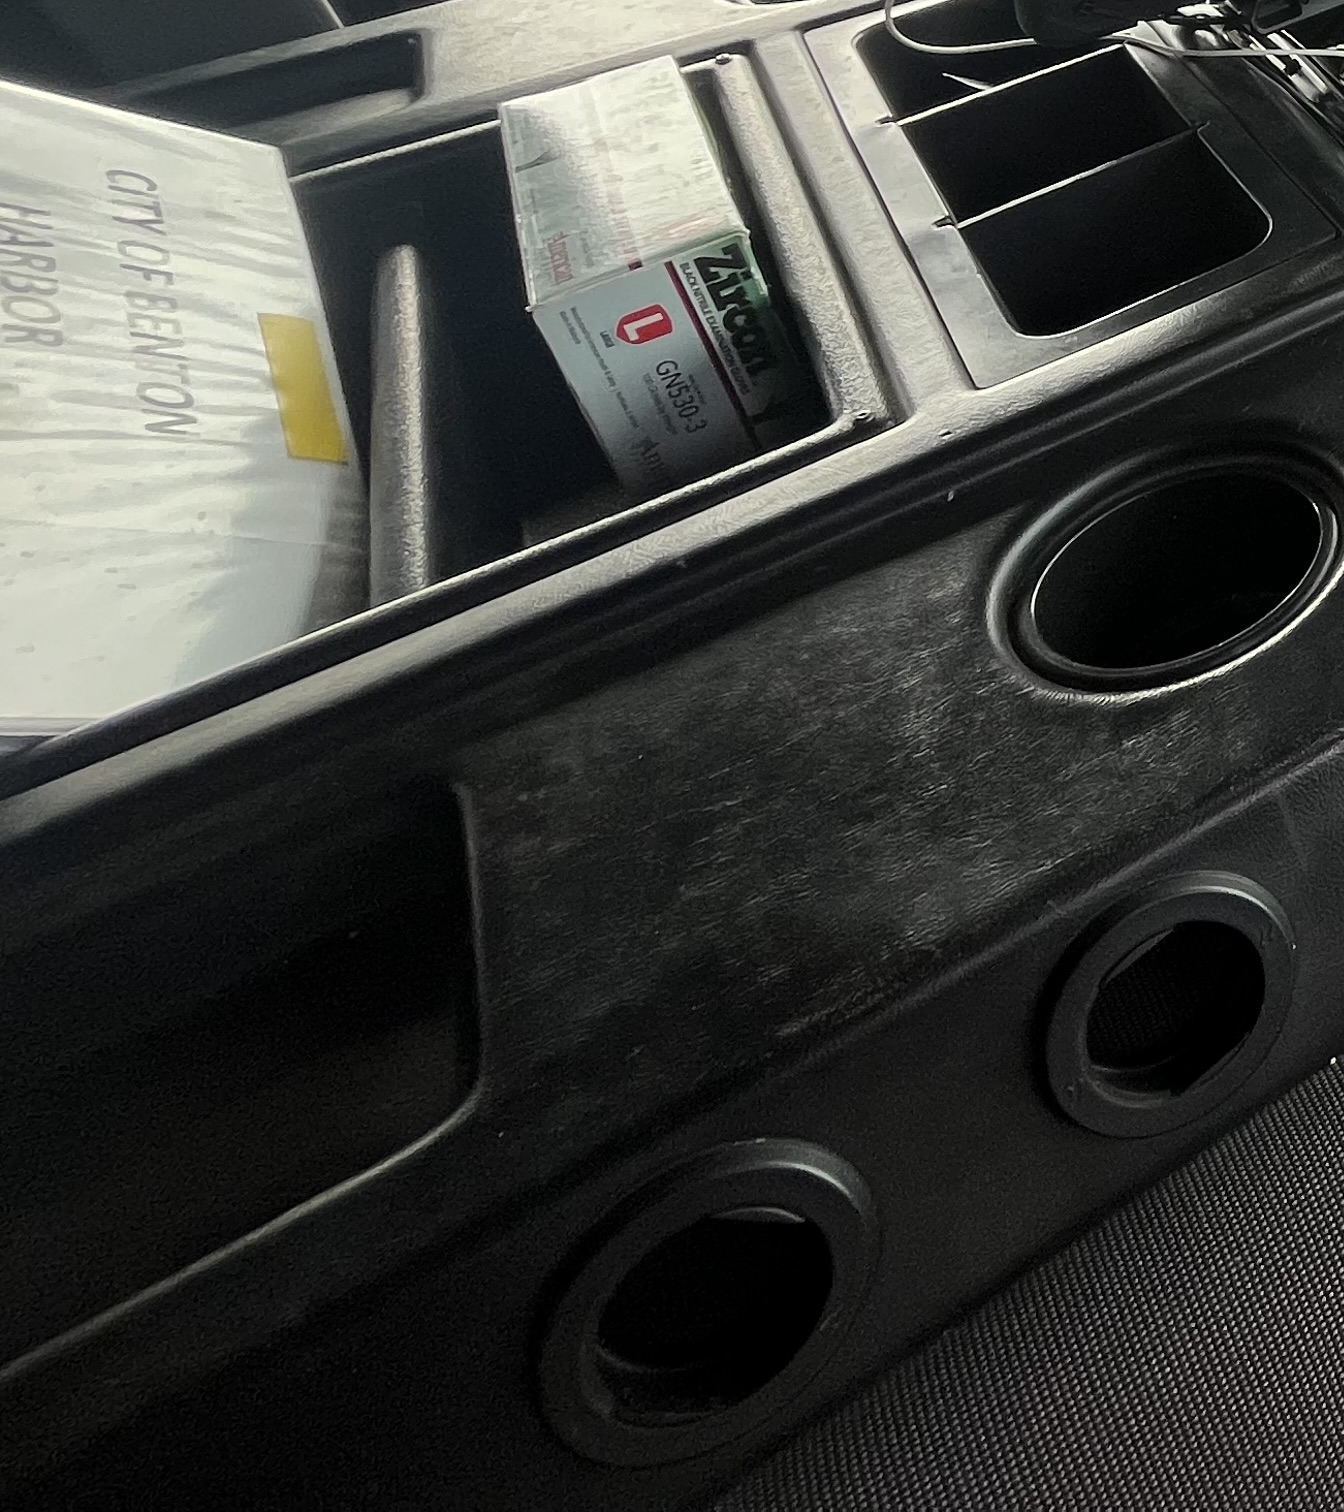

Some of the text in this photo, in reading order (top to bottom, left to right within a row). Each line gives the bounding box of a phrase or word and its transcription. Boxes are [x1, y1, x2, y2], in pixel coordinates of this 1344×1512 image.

[0, 202, 64, 347] HARBOR
[105, 169, 198, 436] CITY OF BENTON
[680, 262, 698, 288] BLACK
[694, 244, 777, 376] Zircon
[623, 312, 664, 342] L
[656, 359, 708, 433] GN530-3
